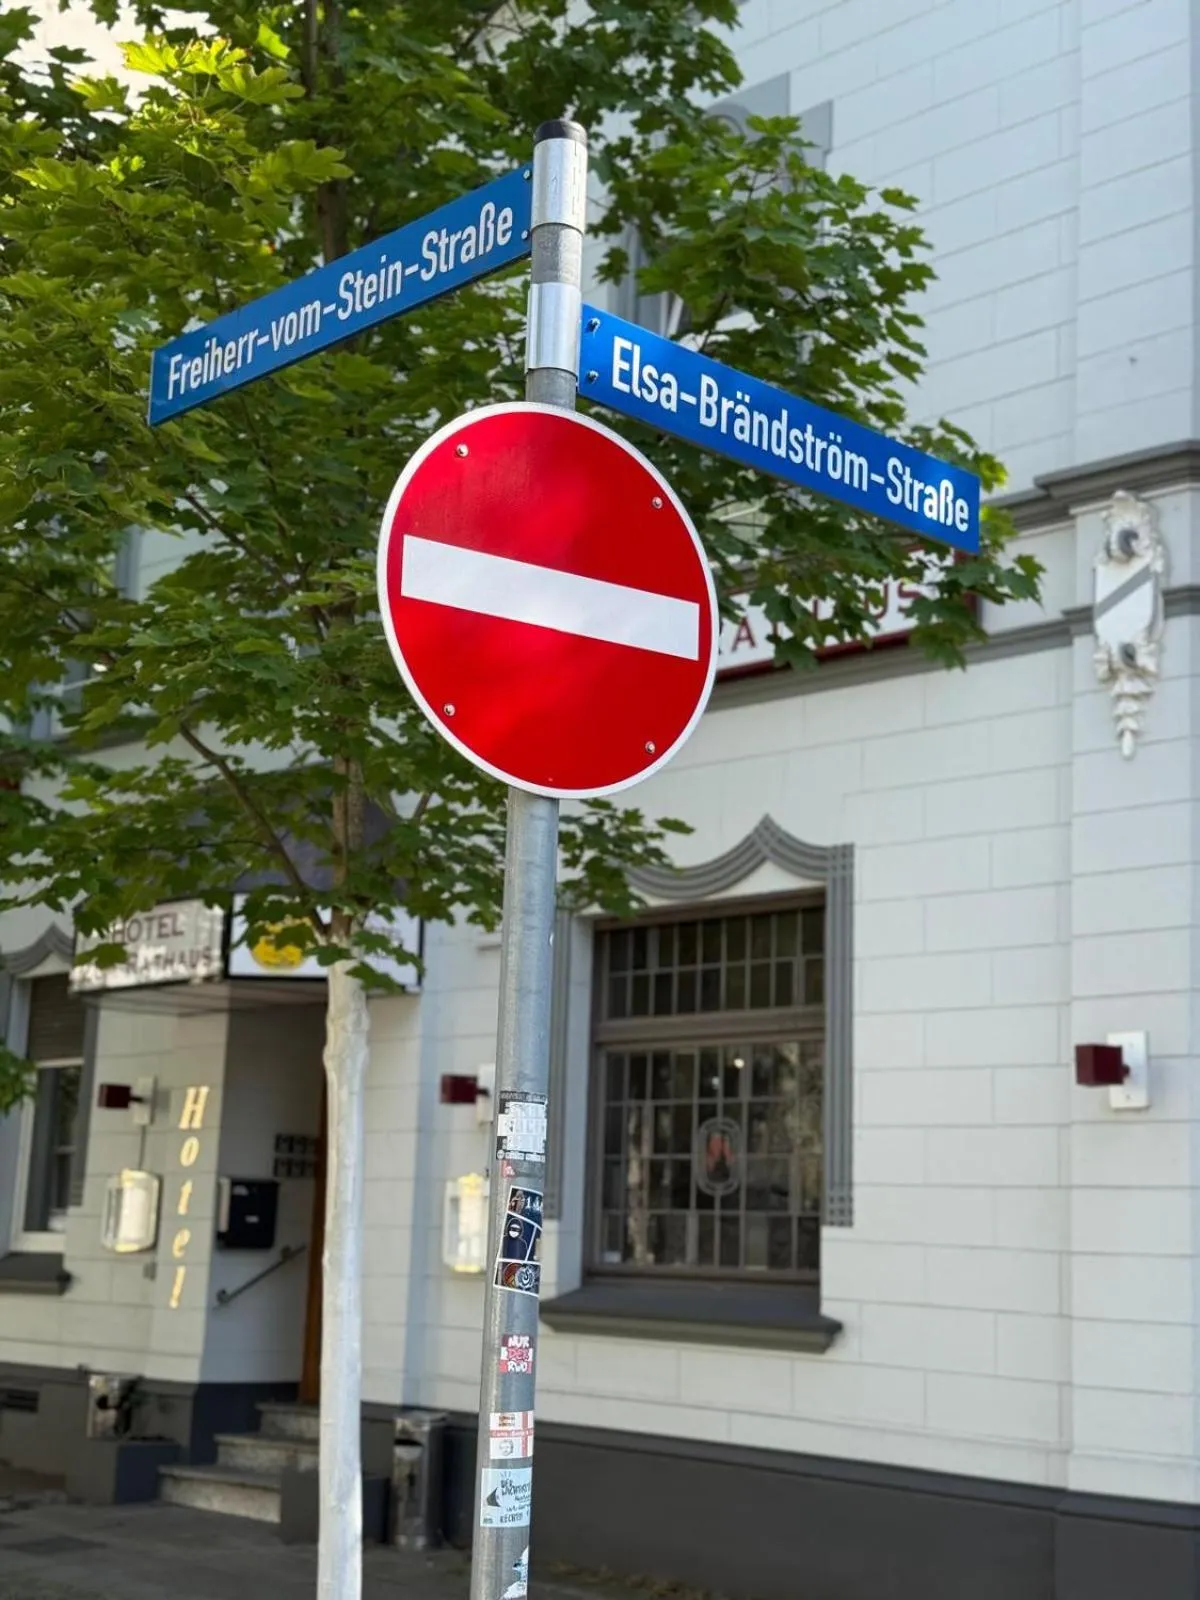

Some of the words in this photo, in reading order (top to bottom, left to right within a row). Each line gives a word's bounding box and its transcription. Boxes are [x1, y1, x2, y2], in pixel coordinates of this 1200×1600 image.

[167, 200, 514, 400] Freiherr-vom-Stein-Straße
[610, 335, 970, 533] Elsa-Brändström-Straße
[112, 912, 184, 944] HOTEL
[169, 1085, 209, 1309] Hotel
